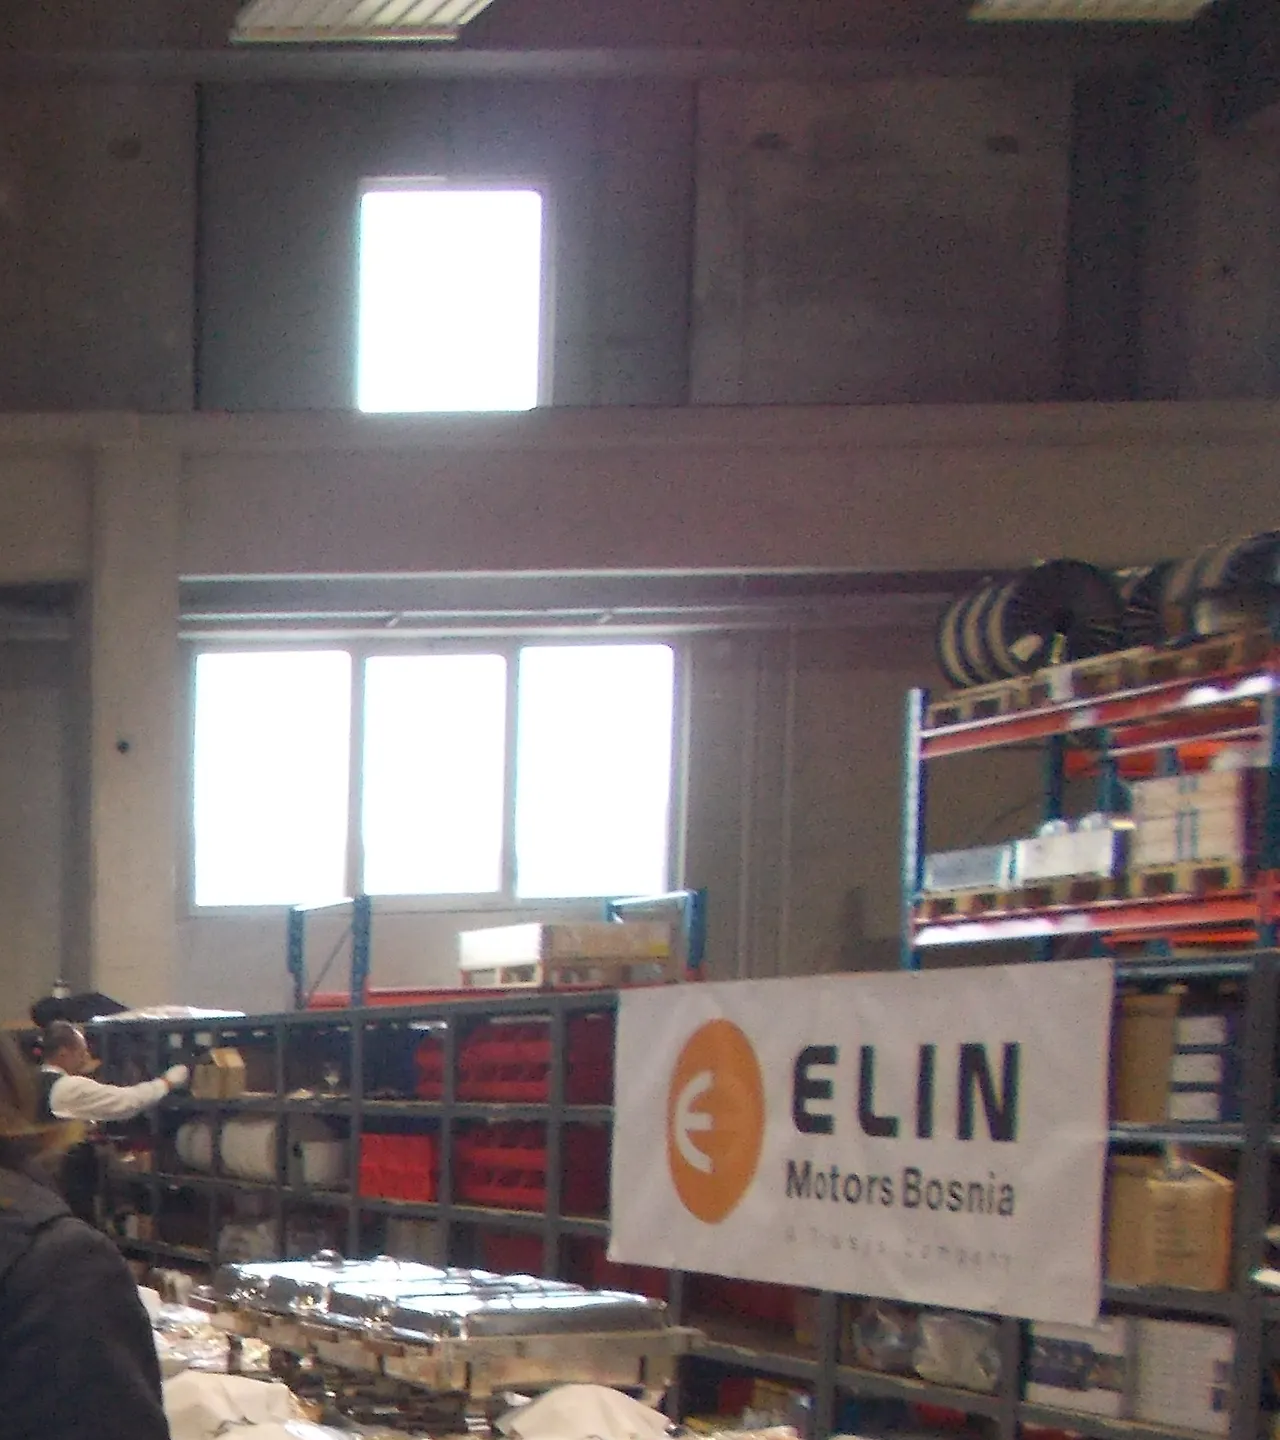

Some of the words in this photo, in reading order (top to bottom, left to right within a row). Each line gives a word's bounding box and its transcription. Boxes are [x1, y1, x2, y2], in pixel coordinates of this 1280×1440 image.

[792, 1041, 1021, 1142] ELIN
[785, 1159, 894, 1208] Motors
[900, 1165, 1017, 1217] Bosnia
